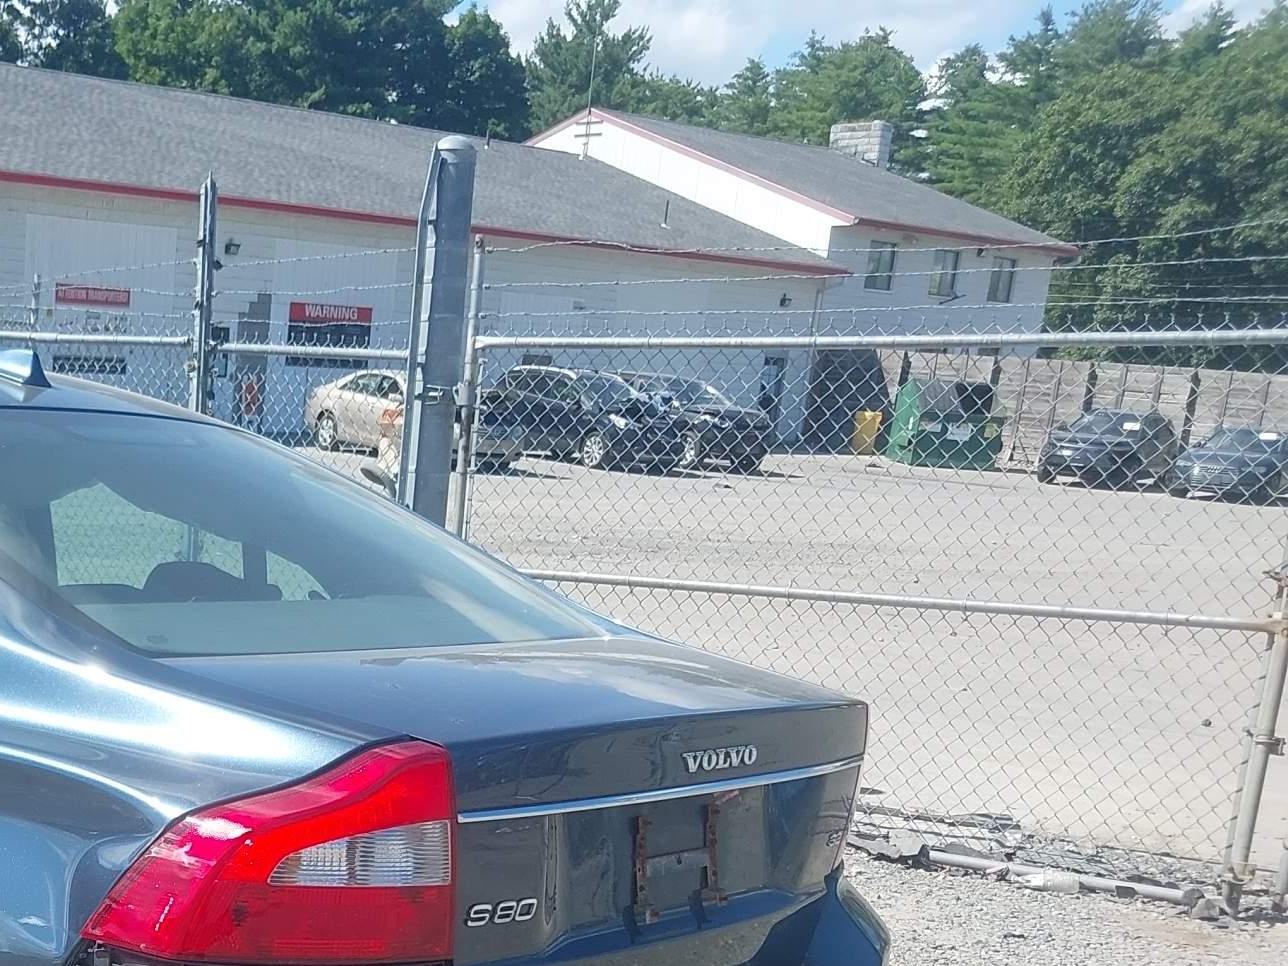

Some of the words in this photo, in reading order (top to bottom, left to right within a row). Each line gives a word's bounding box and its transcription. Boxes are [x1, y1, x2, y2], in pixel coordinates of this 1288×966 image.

[305, 303, 358, 320] WARNING
[682, 744, 758, 774] VOLVO
[466, 898, 539, 928] S80
